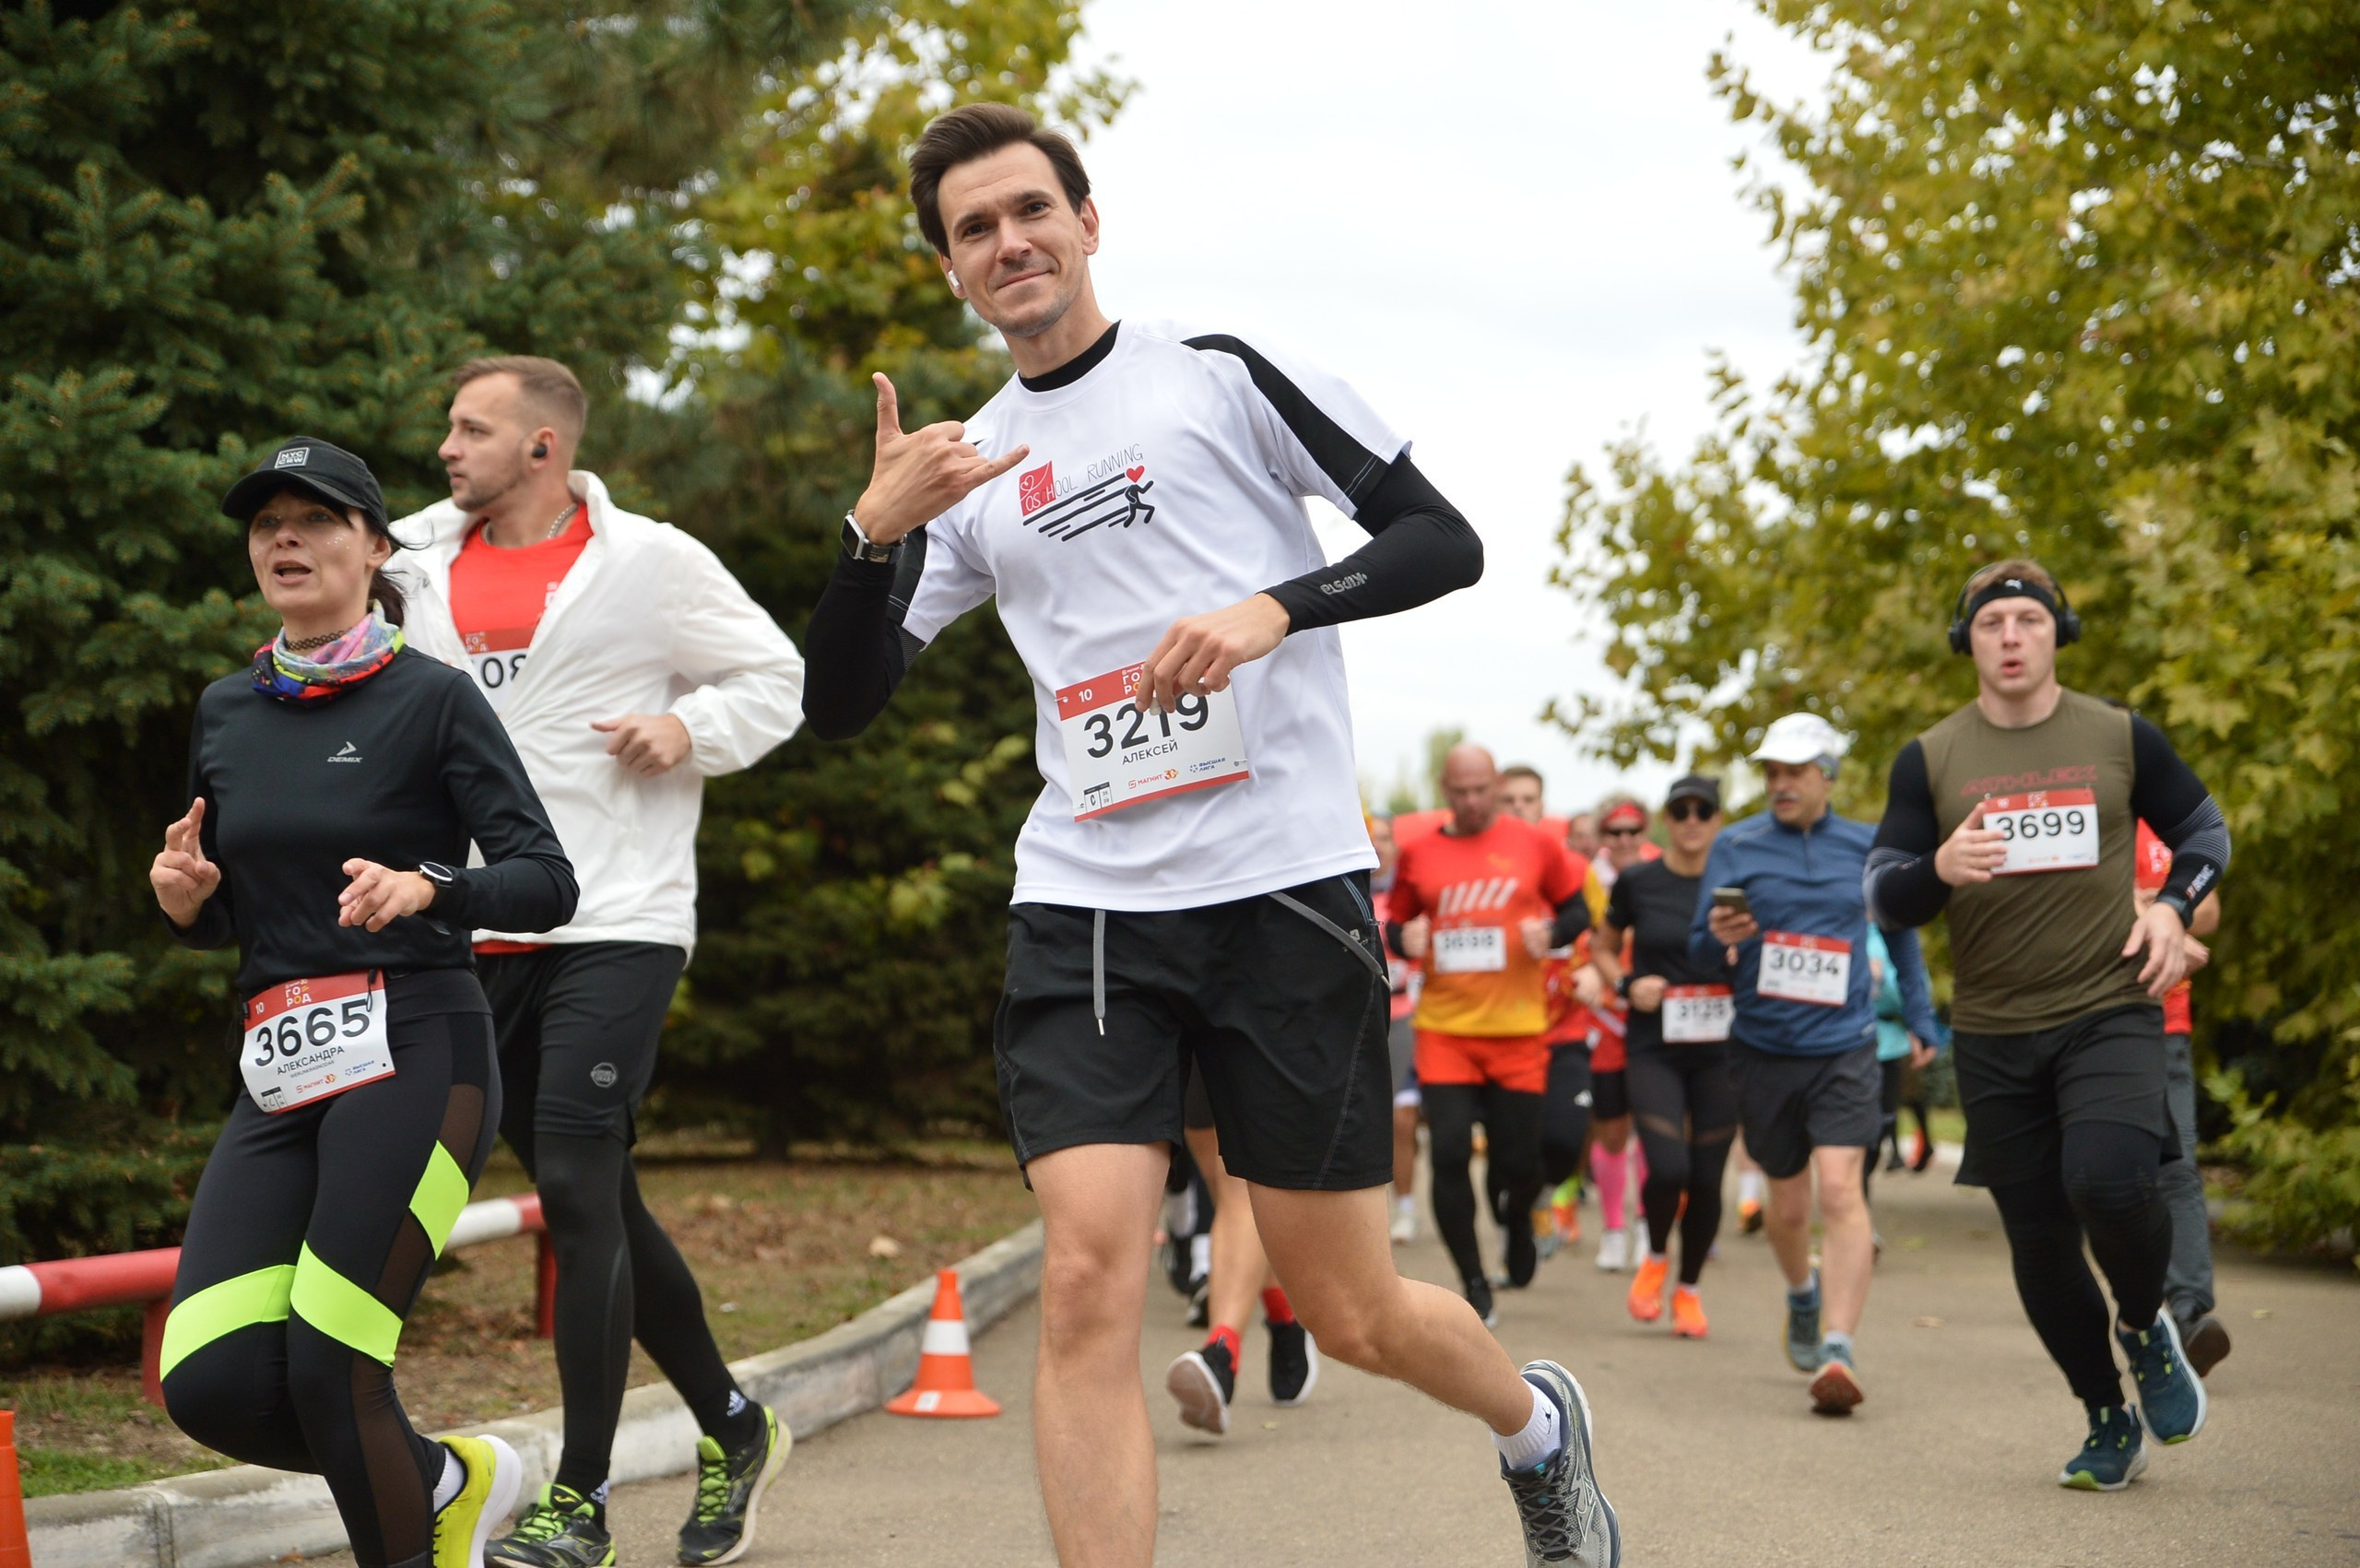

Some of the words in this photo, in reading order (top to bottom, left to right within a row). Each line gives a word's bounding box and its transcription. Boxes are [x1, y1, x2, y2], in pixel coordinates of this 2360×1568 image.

[281, 451, 304, 460] NYC
[1086, 442, 1144, 482] RUNNING
[1122, 671, 1141, 686] ГО
[1078, 688, 1093, 703] 10
[1083, 691, 1210, 759] 3219
[1122, 738, 1179, 765] АЛЕКСЕЙ
[1198, 757, 1226, 767] ВЫСШАЯ
[1198, 764, 1216, 772] ЛИГА
[1138, 773, 1163, 785] МАГНИТ
[1996, 809, 2085, 841] 3699
[1768, 947, 1840, 977] 3034
[285, 985, 301, 998] ГО
[255, 1001, 266, 1015] 10
[287, 993, 312, 1008] РОД
[254, 998, 370, 1067] 3665
[277, 1045, 345, 1075] АЛЕКСАНДРА
